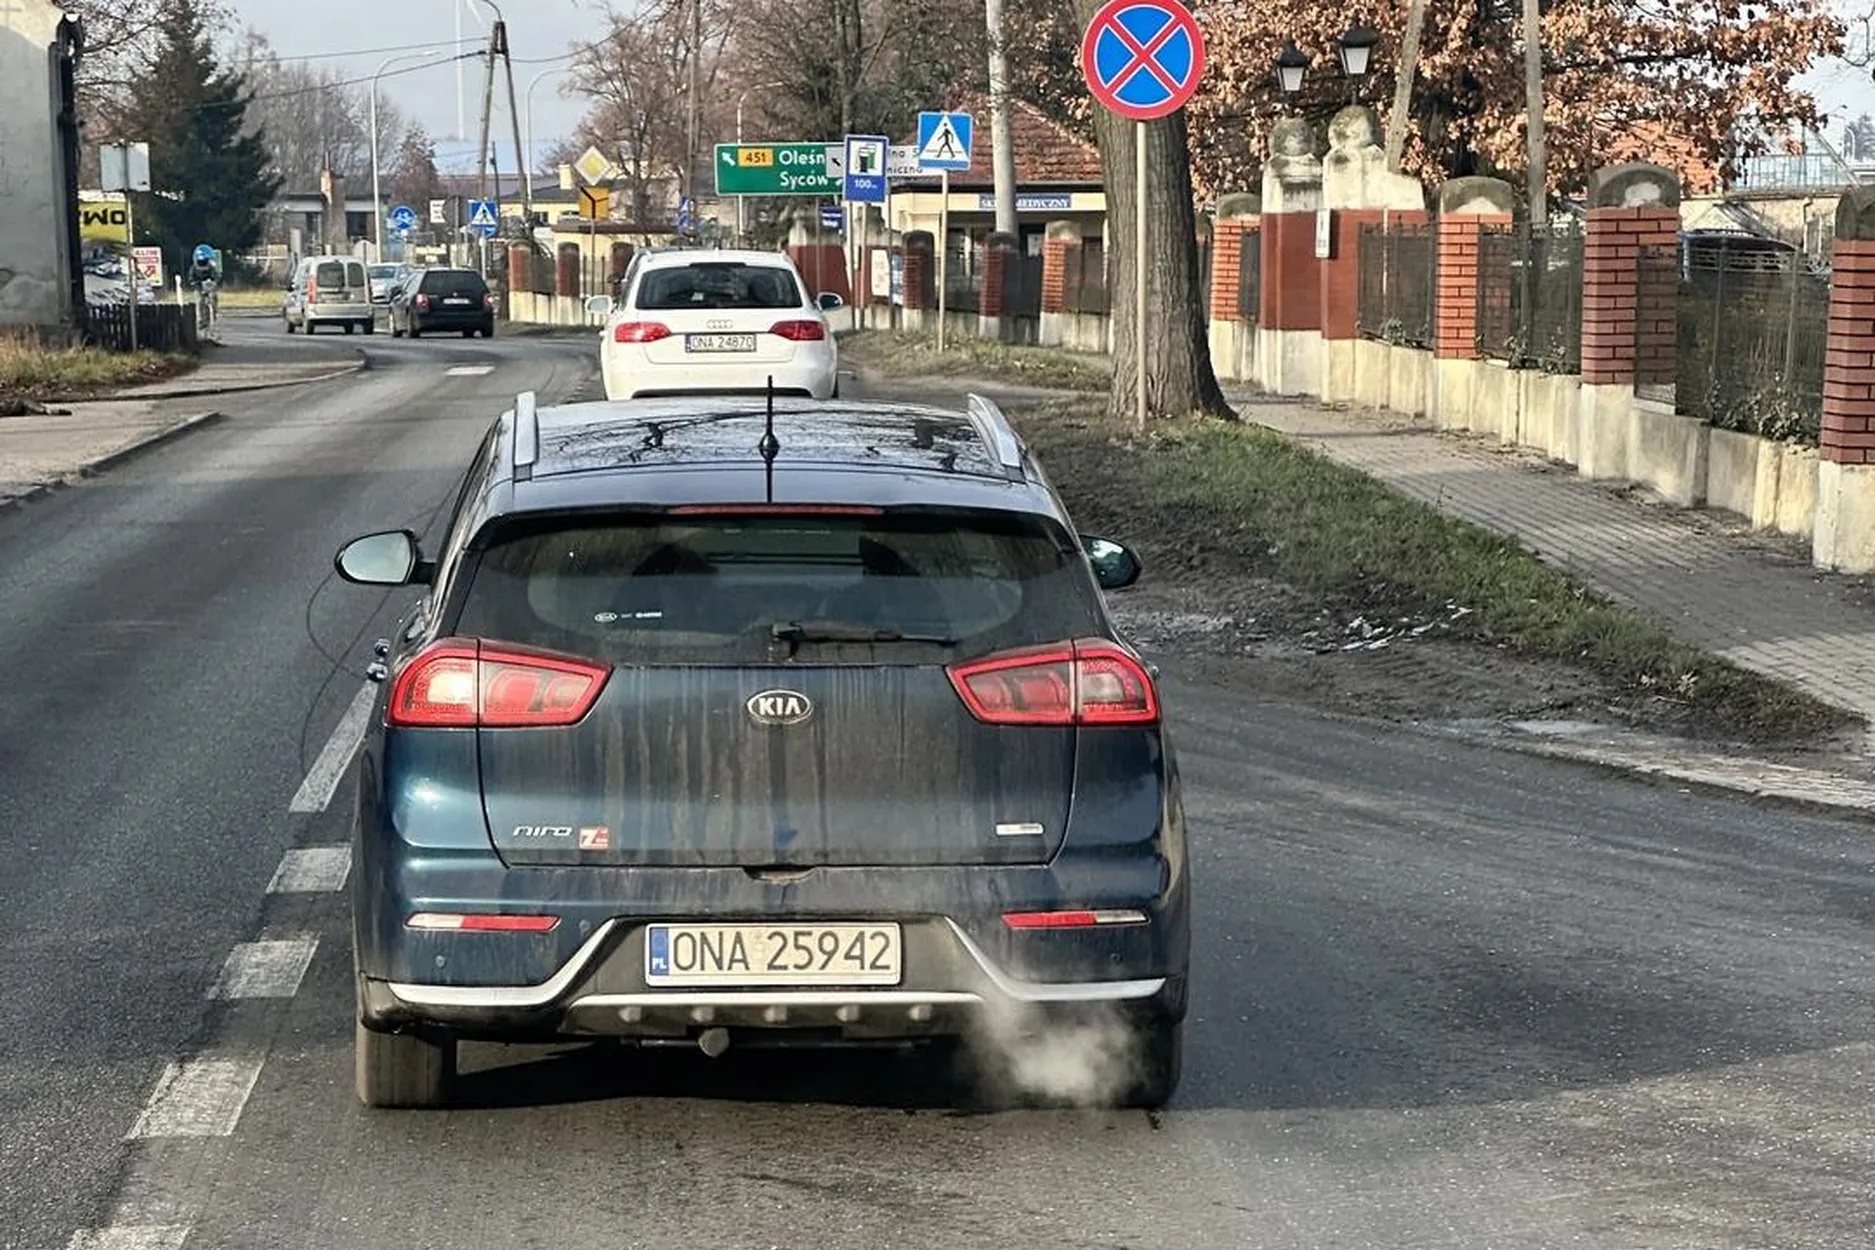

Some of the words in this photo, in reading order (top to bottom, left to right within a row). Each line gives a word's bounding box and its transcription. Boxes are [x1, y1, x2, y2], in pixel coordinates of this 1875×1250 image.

[746, 152, 766, 163] 451
[779, 149, 826, 165] Oleśn
[886, 166, 923, 174] niczna
[779, 170, 829, 190] Syców
[692, 336, 714, 348] ONA
[758, 697, 801, 716] KIA
[673, 931, 750, 971] ONA
[766, 931, 891, 971] 25942
[651, 957, 668, 969] PL
